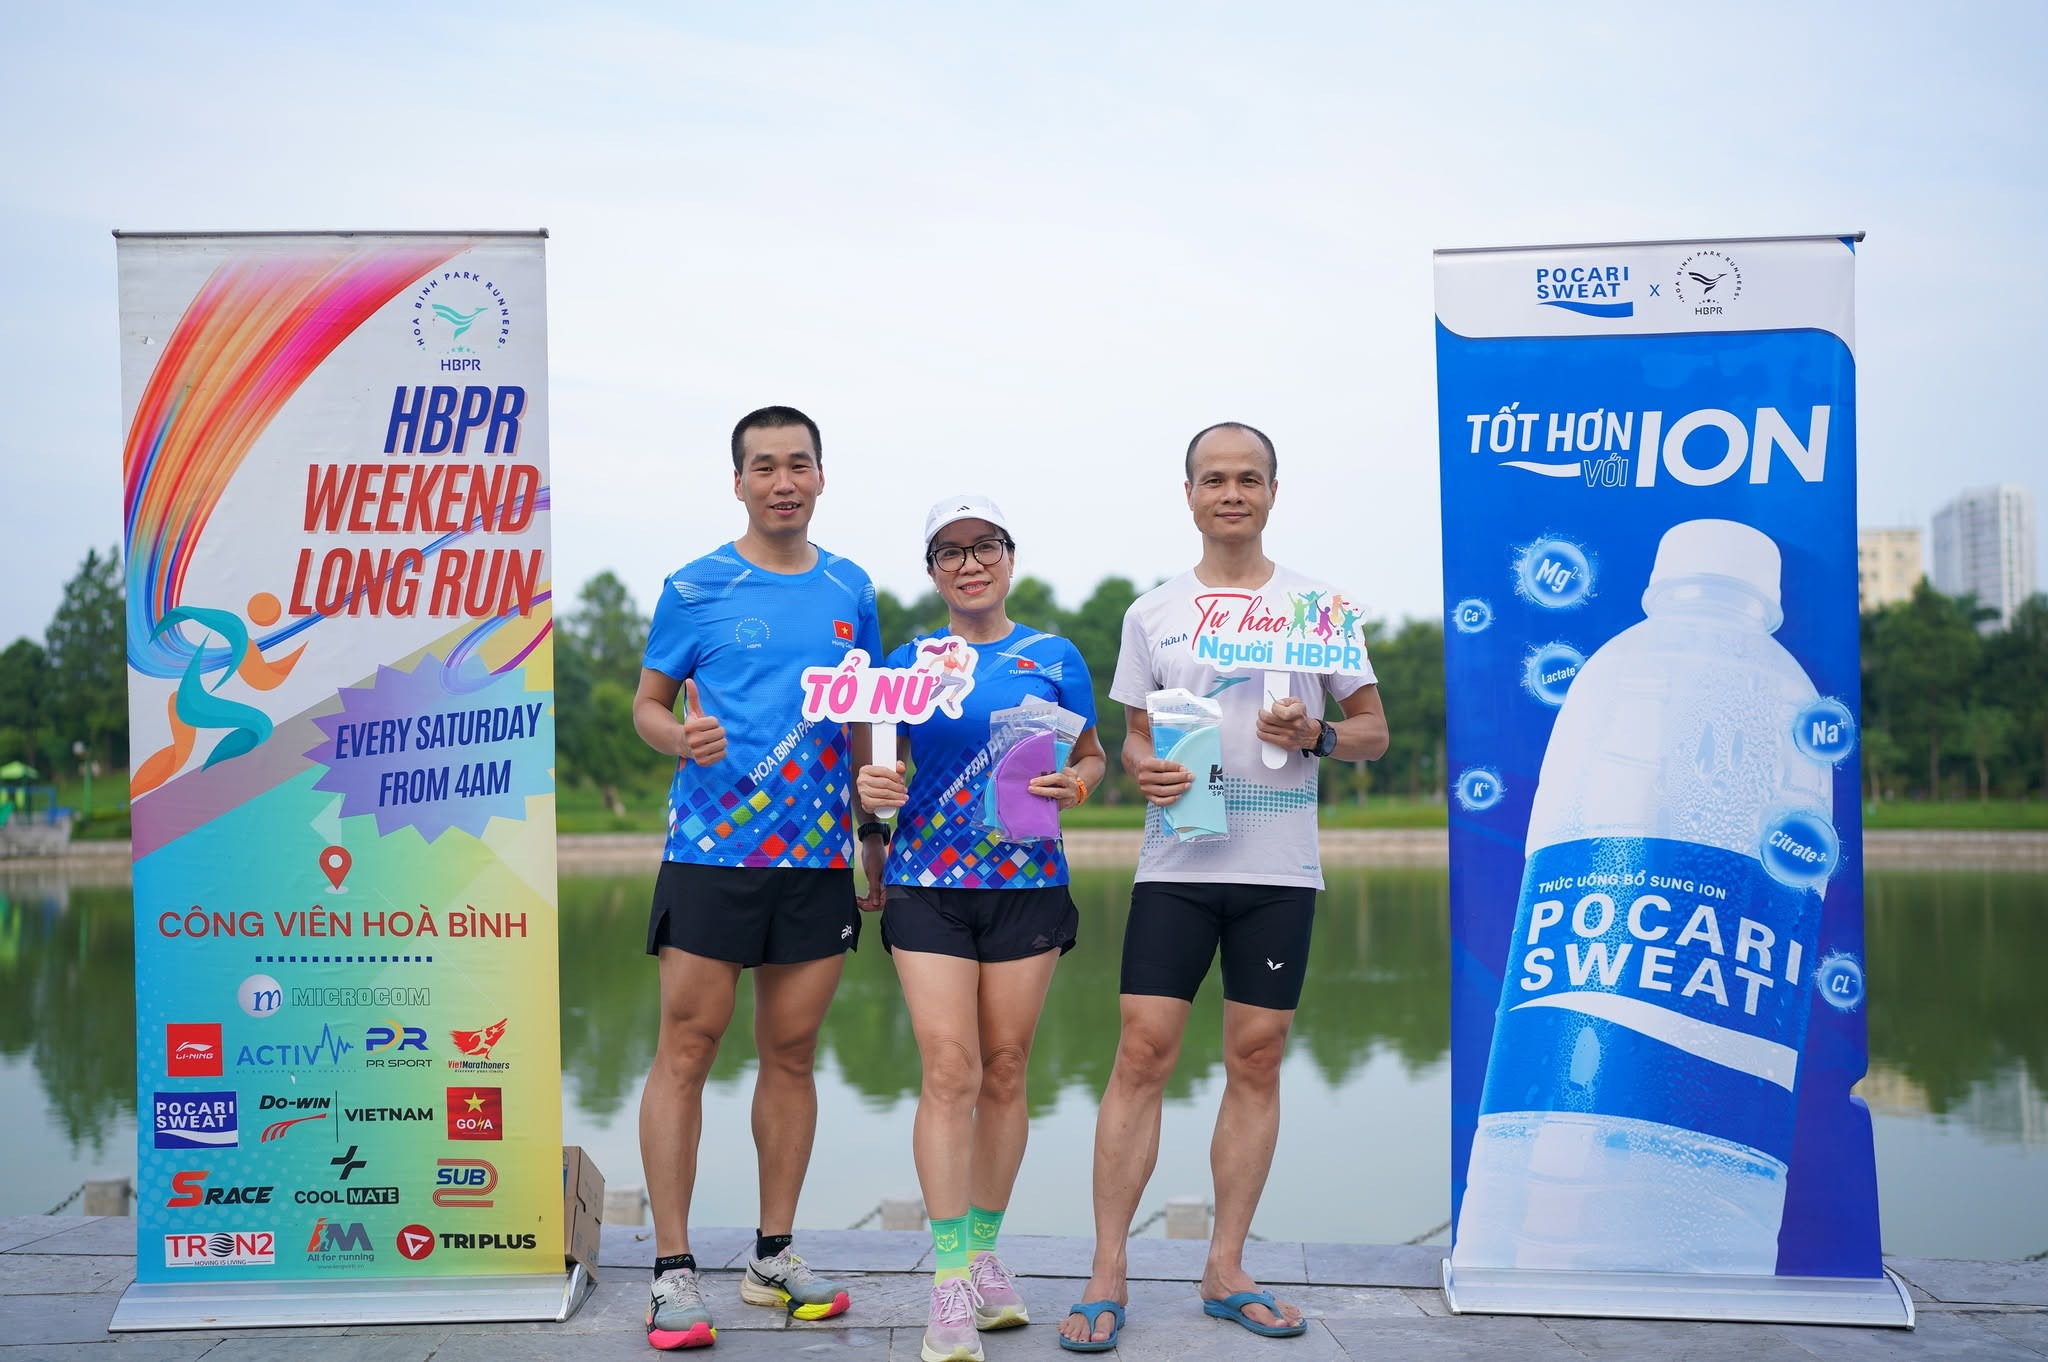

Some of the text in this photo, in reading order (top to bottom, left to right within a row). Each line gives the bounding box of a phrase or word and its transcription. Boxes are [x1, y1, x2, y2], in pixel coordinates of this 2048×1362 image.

[1536, 266, 1629, 283] POCARI
[1536, 283, 1621, 300] SWEAT
[412, 271, 510, 346] HOA BINH PARK RUNNERS
[1694, 306, 1723, 315] HBPR
[440, 359, 481, 371] HBPR
[384, 385, 528, 456] HBPR
[1466, 401, 1633, 454] TỐT HƠN
[1635, 405, 1831, 488] ION
[1583, 452, 1629, 488] VỚI
[303, 463, 540, 533] WEEKEND
[288, 548, 543, 618] LONG RUN
[1237, 595, 1294, 634] hào
[1198, 635, 1362, 670] Người HBPR
[807, 656, 941, 716] TỔ NỮ
[335, 703, 543, 760] EVERY SATURDAY
[749, 755, 779, 786] HOA
[773, 728, 801, 763] BINH
[378, 759, 512, 808] FROM 4AM
[1538, 869, 1727, 901] THỨC UỐNG BỔ SUNG ION
[158, 903, 528, 938] CÔNG VIÊN HOÀ BÌNH
[1526, 892, 1804, 987] POCARI
[292, 988, 431, 1006] MICROCOM
[1520, 942, 1774, 1017] SWEAT
[175, 1052, 214, 1060] LI-NING
[366, 1059, 433, 1068] PR SPORT
[447, 1060, 510, 1070] VietMarathoners
[156, 1101, 234, 1115] POCARI
[156, 1114, 227, 1129] SWEAT
[344, 1107, 434, 1121] VIETNAM
[307, 1254, 320, 1262] All
[339, 1253, 375, 1262] running
